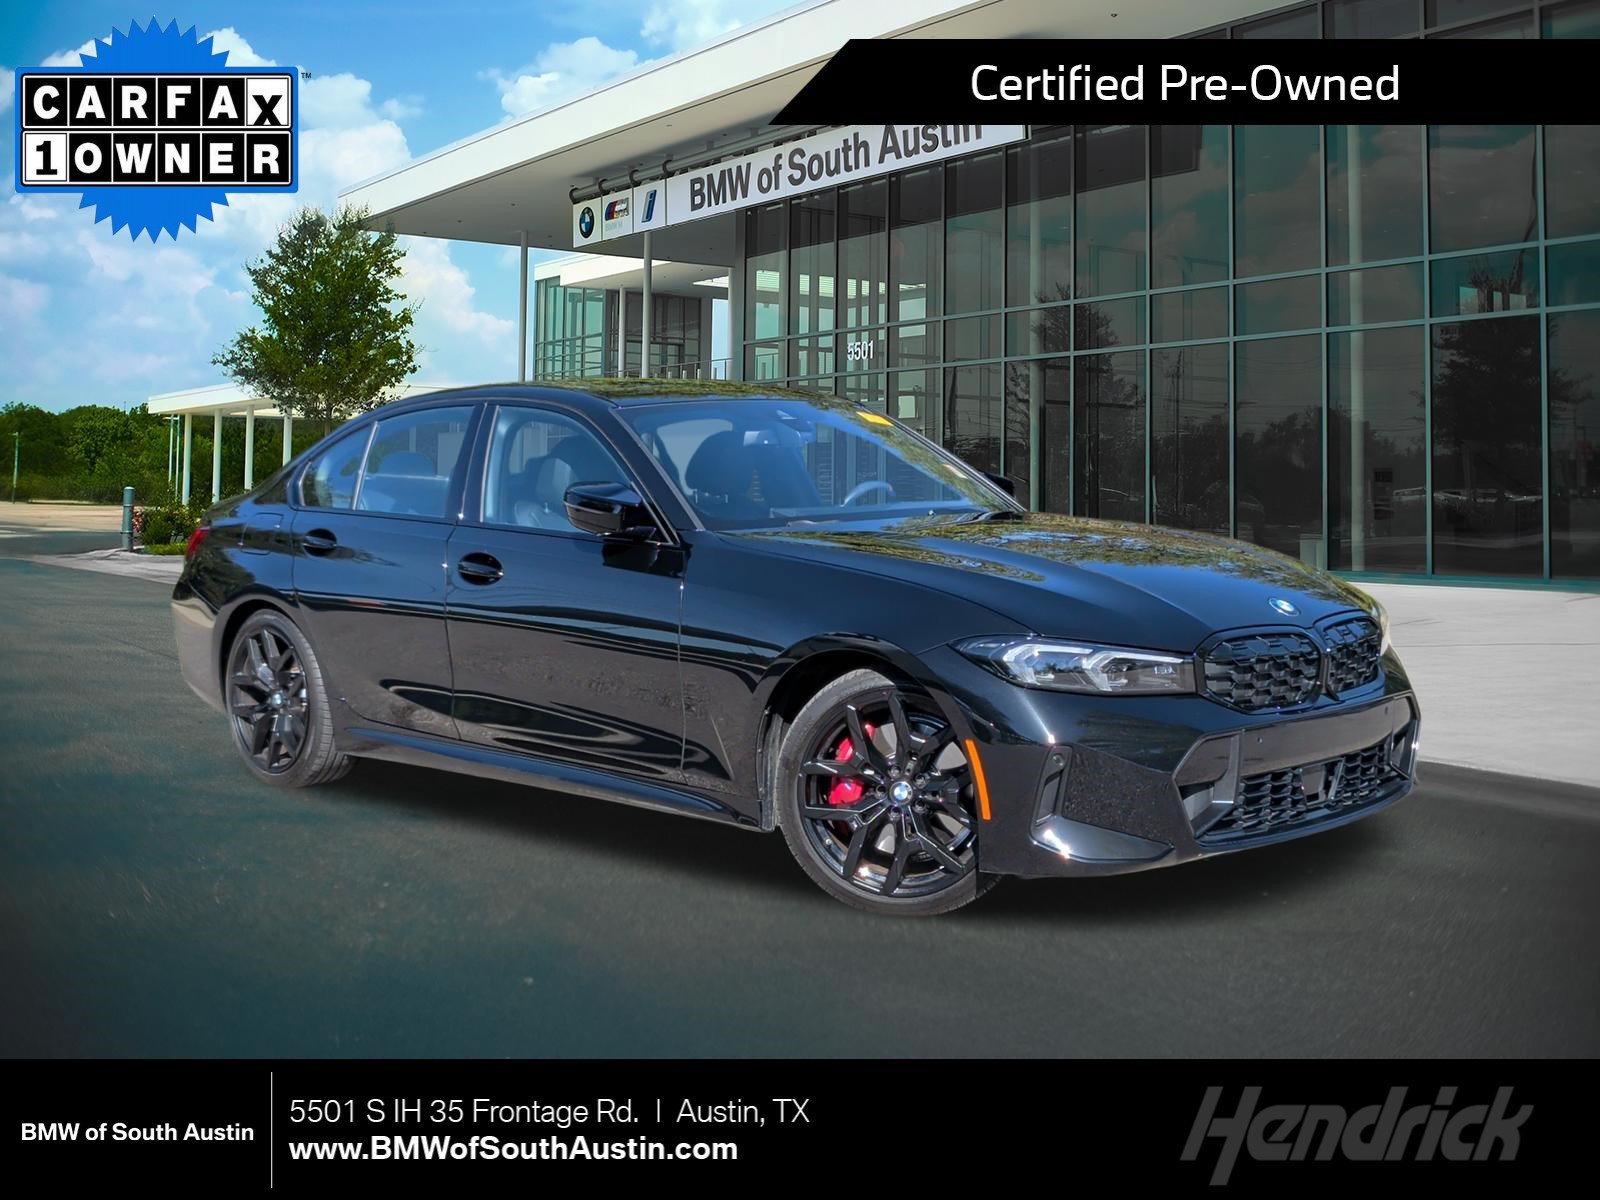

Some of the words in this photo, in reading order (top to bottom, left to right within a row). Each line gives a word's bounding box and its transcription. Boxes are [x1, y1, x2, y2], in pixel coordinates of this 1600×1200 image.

[690, 162, 751, 212] BMW
[757, 153, 782, 194] of
[787, 131, 870, 187] South
[847, 340, 874, 361] 5501
